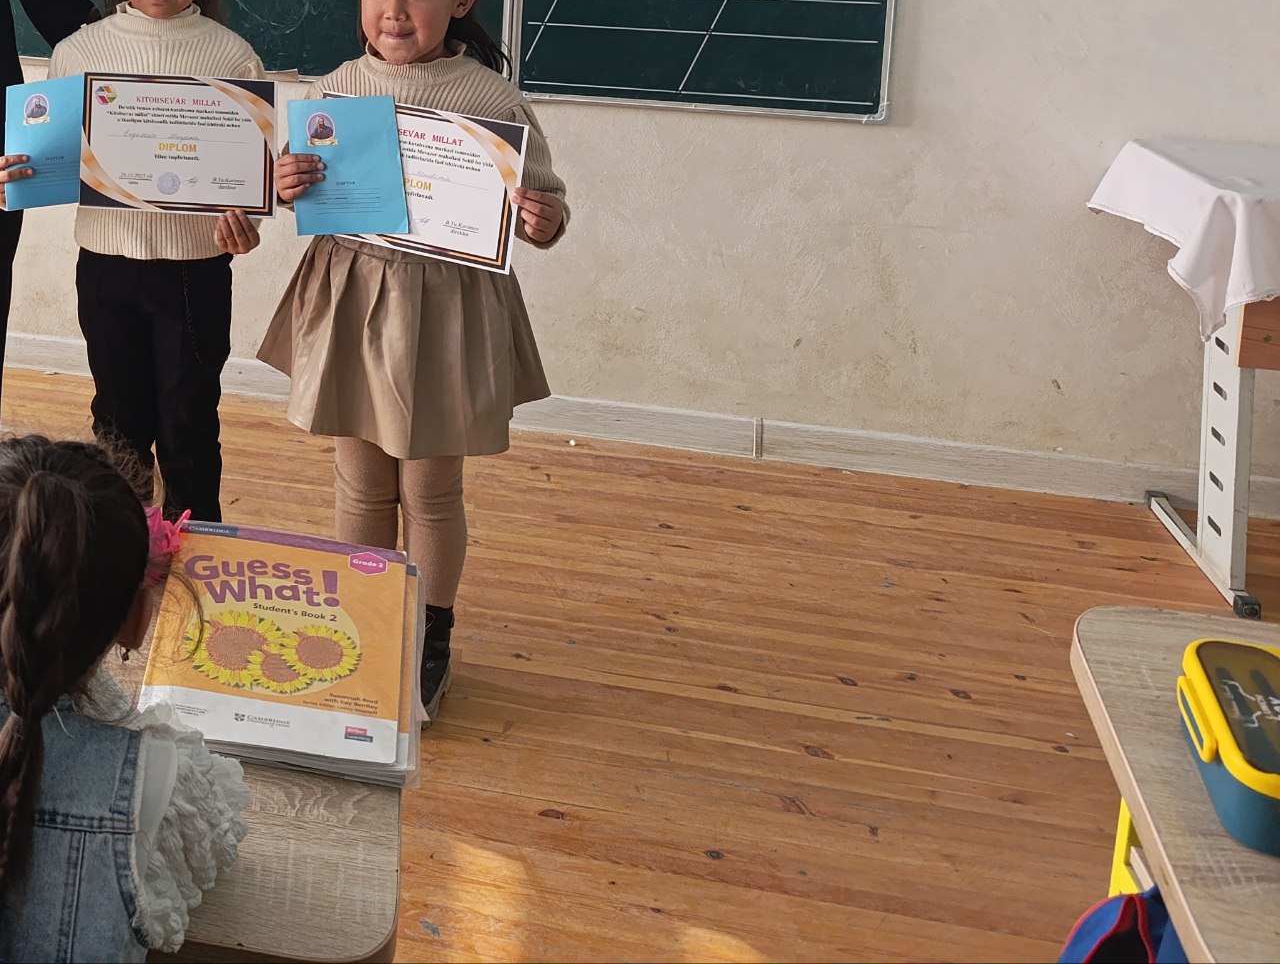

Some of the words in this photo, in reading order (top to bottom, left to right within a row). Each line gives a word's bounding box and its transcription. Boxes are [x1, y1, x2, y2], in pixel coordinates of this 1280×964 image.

[136, 97, 186, 105] KITOBSEVAR
[398, 128, 426, 140] SEVAR
[432, 135, 463, 146] MILLAT
[158, 143, 197, 153] DIPLOM
[404, 178, 432, 191] PLOM
[353, 559, 377, 567] Grade
[185, 555, 313, 586] Guess
[253, 603, 298, 616] Student's
[301, 610, 326, 620] Book
